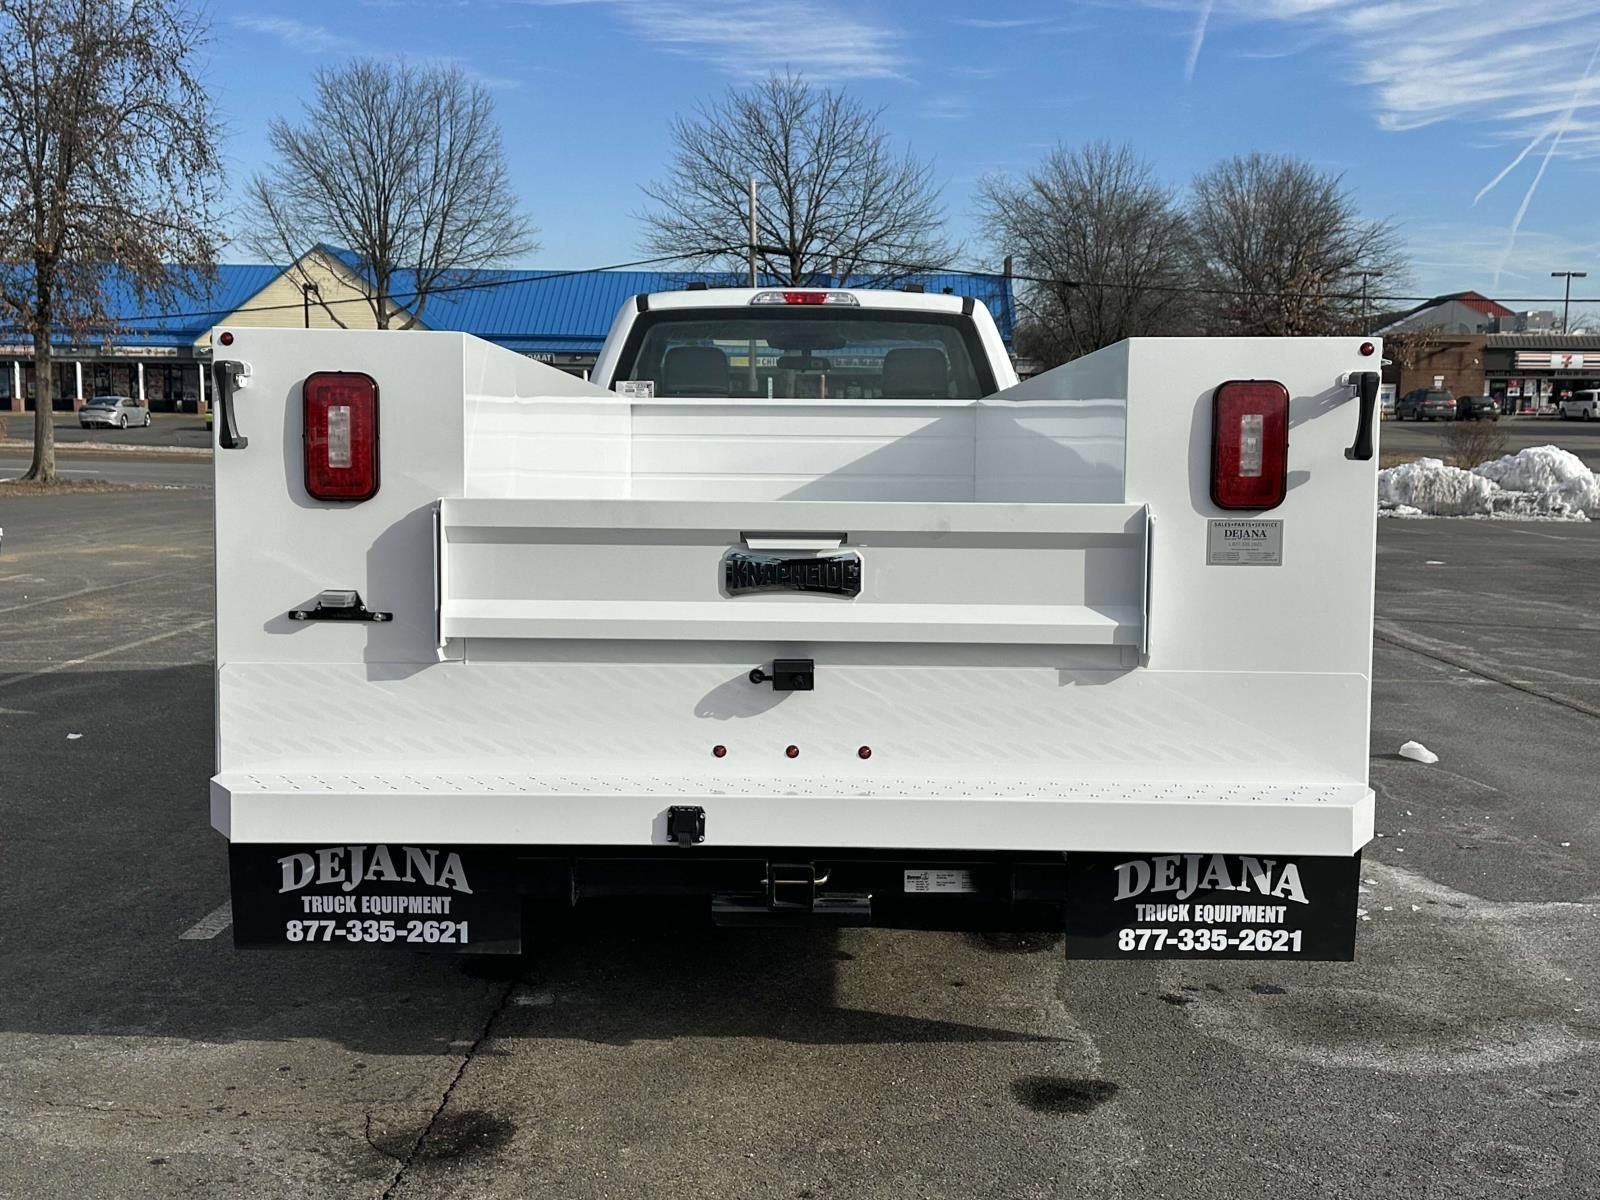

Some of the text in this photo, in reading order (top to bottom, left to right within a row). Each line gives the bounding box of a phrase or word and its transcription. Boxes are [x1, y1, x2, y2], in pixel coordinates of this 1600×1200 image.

[1224, 529, 1267, 539] DEJANA
[277, 844, 474, 894] DEJANA
[1113, 854, 1309, 904] DEJANA
[301, 895, 452, 915] TRUCK EQUIPMENT
[1135, 904, 1287, 924] TRUCK EQUIPMENT
[286, 919, 469, 943] 877-335-2621
[1118, 928, 1302, 952] 877-335-2621
